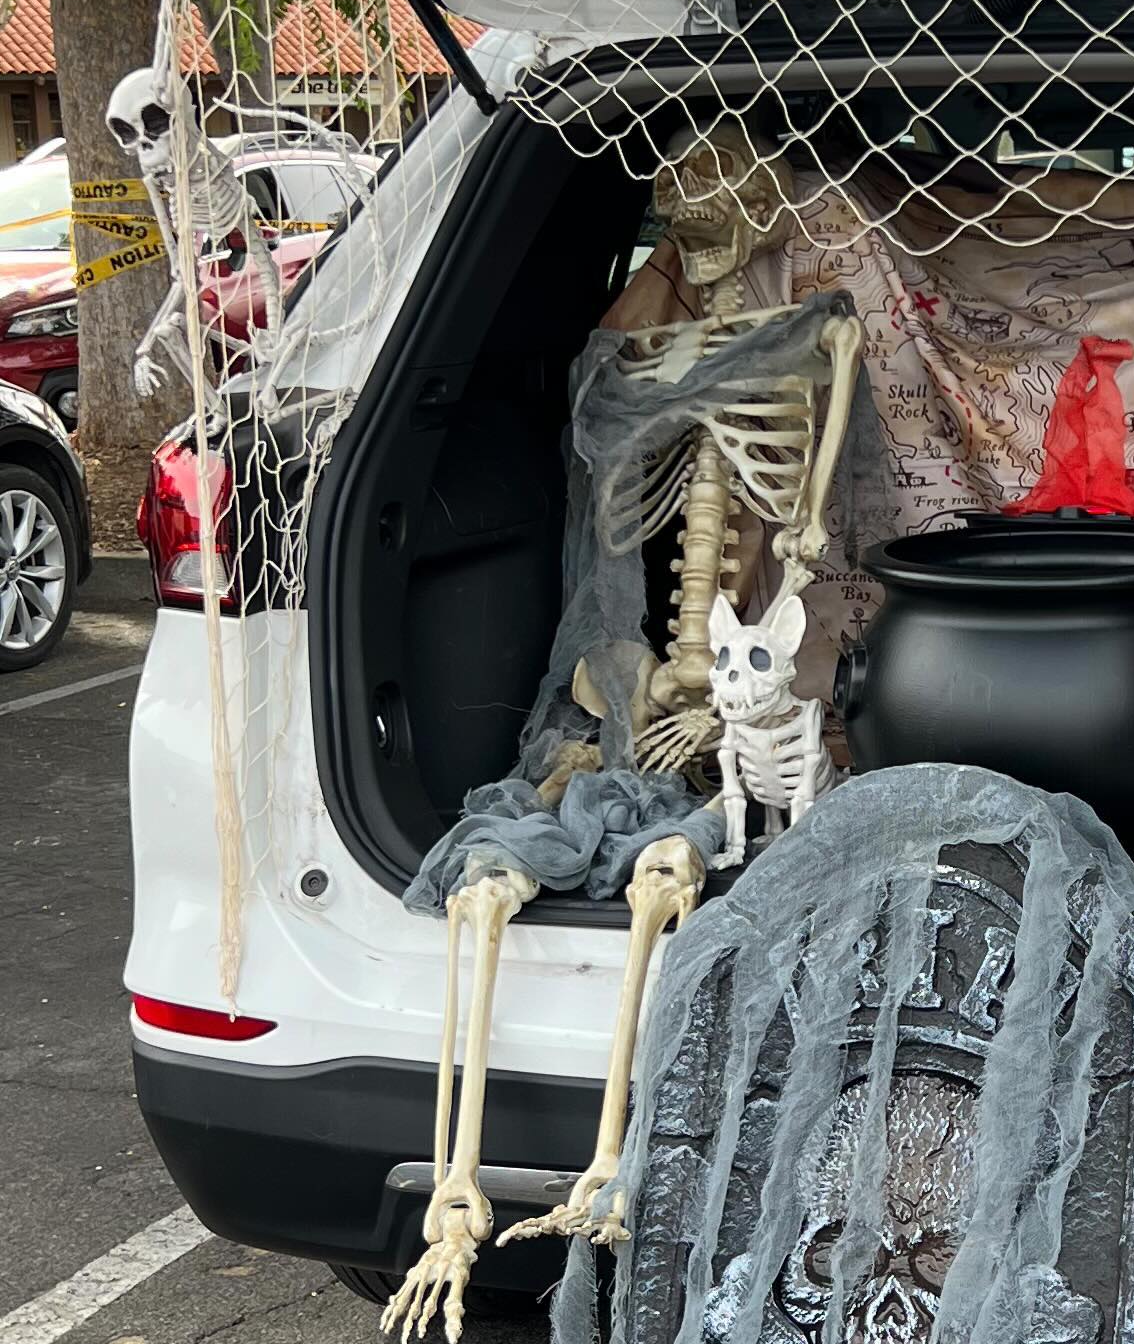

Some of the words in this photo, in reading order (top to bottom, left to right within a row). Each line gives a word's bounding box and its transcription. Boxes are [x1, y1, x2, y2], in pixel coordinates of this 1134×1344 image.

[888, 384, 928, 404] Skull
[889, 403, 934, 424] Rock
[980, 439, 1005, 452] Red
[913, 495, 947, 510] Frog
[951, 496, 979, 506] river
[841, 586, 872, 603] Bay
